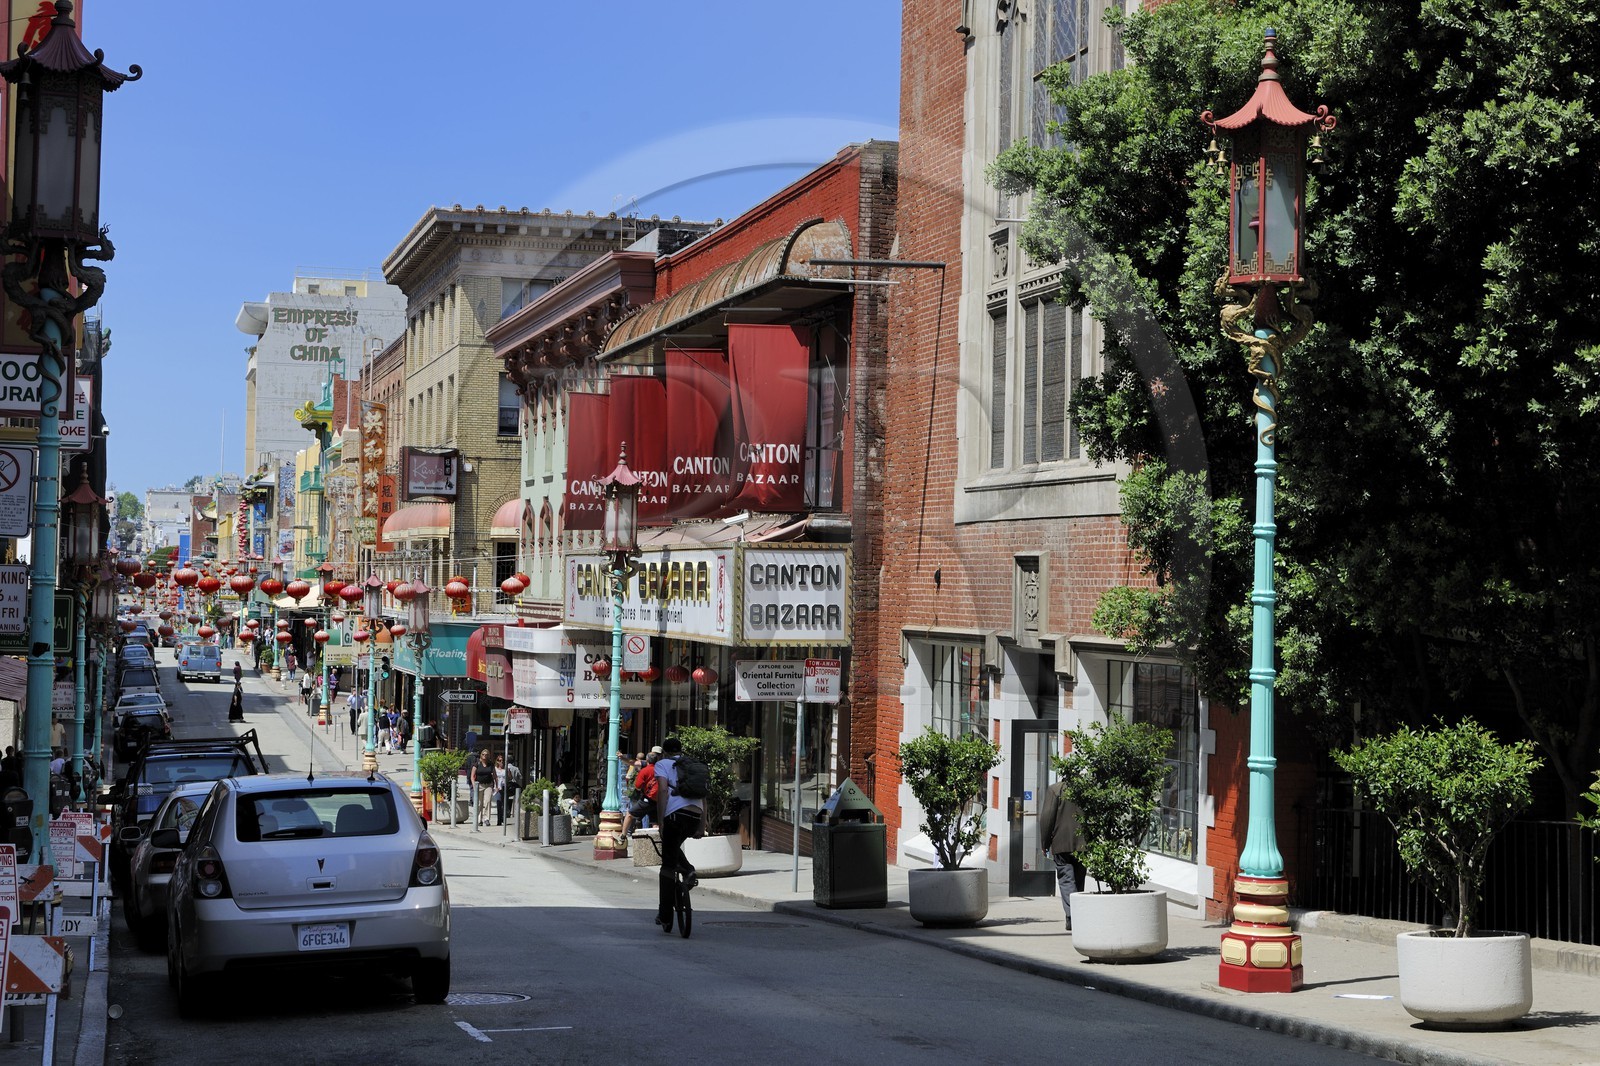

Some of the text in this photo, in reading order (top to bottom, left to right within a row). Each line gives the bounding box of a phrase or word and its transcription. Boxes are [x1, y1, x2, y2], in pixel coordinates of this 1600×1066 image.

[272, 307, 359, 327] EMPRESS
[305, 328, 328, 343] OF
[290, 345, 341, 363] CHINA
[739, 443, 800, 465] CANTON
[412, 457, 443, 479] Kan's
[673, 456, 730, 475] CANTON
[736, 472, 799, 484] BAZAAR
[639, 561, 712, 603] BAZAAR
[750, 563, 840, 586] CANTON
[596, 607, 610, 619] unique
[640, 606, 651, 621] from
[667, 607, 683, 623] orient
[750, 603, 840, 626] BAZAAR
[429, 648, 467, 661] Floating
[742, 671, 773, 679] Oriental
[805, 667, 839, 676] NO STOPPING
[757, 681, 795, 690] Collection
[816, 677, 829, 685] ANY
[815, 686, 830, 694] TIME
[302, 932, 346, 946] 6FGE344
